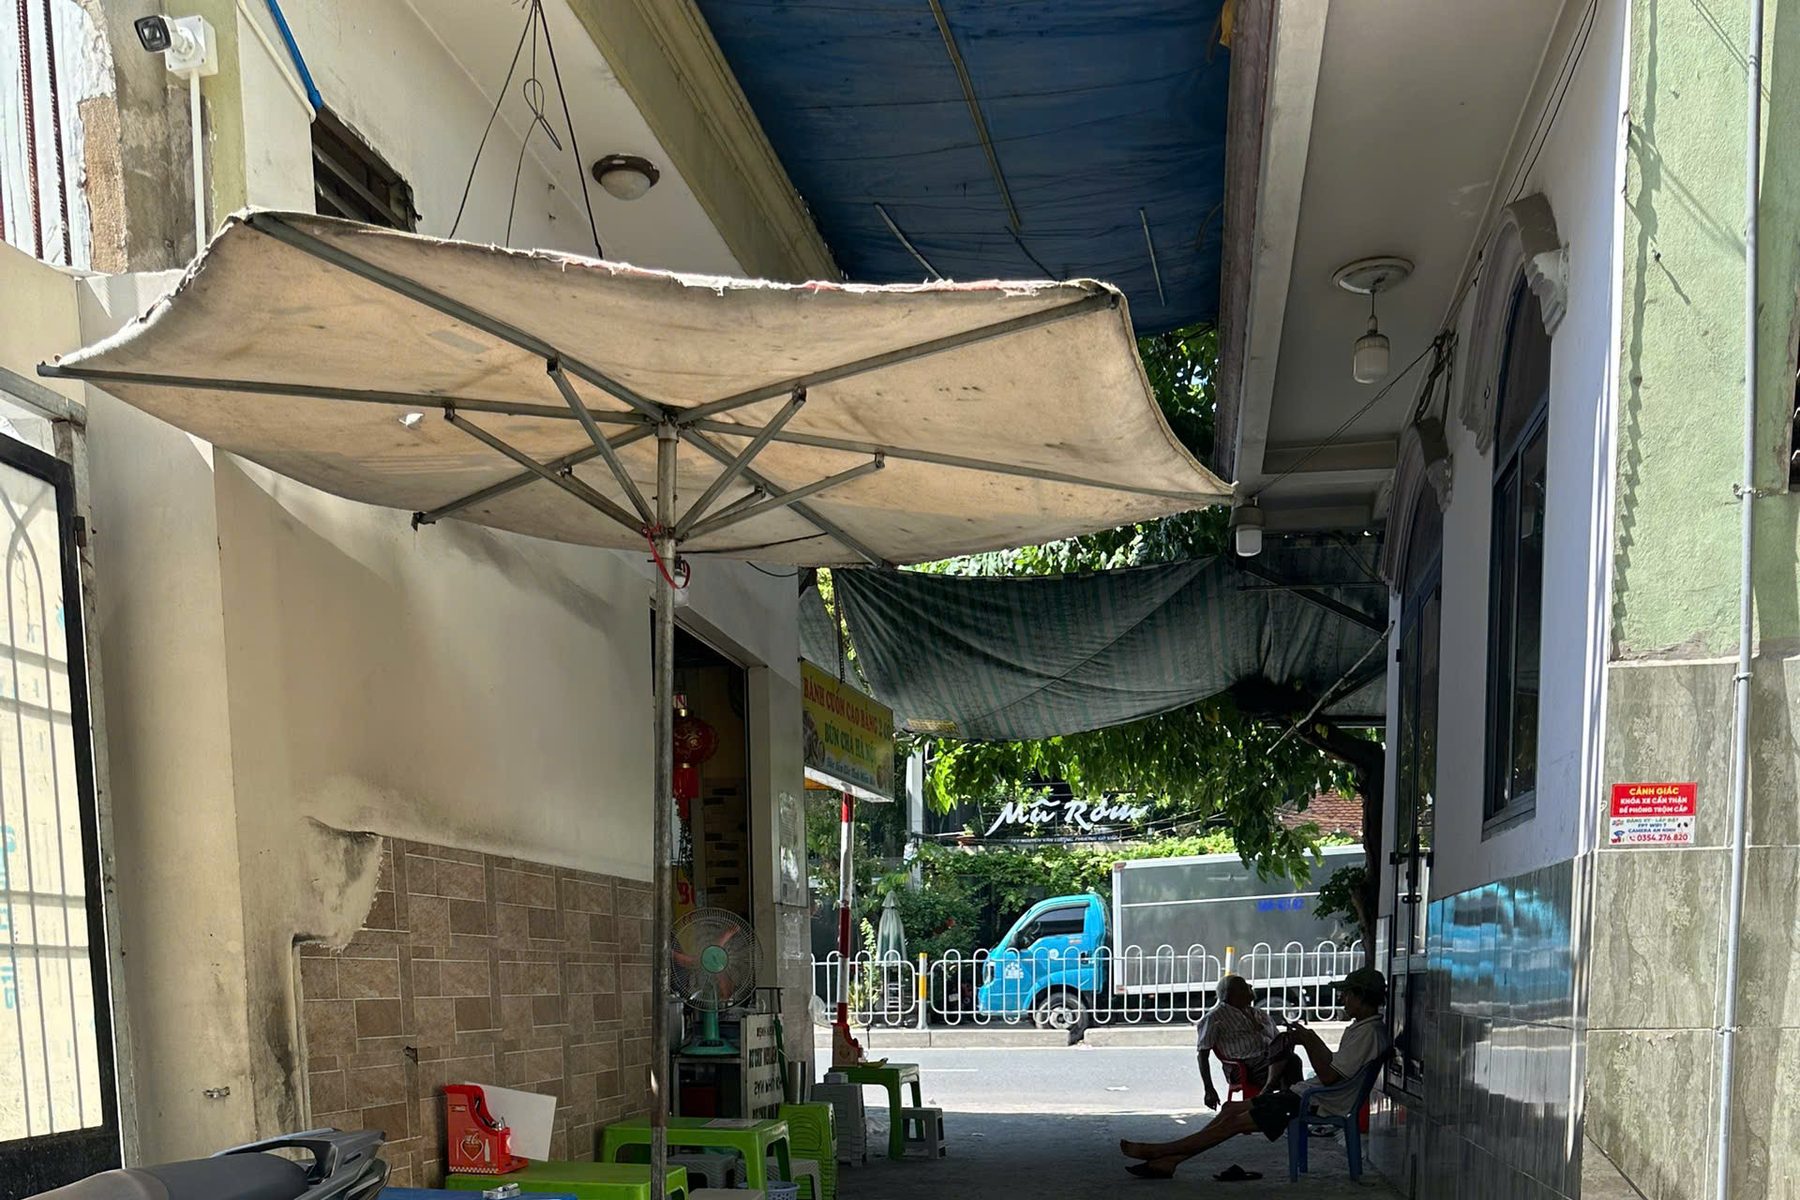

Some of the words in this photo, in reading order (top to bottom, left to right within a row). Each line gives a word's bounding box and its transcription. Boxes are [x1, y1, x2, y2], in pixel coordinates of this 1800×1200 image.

[803, 675, 825, 707] BÁNH
[826, 687, 845, 717] CUỐN
[1629, 786, 1655, 796] CẢNH
[1656, 785, 1680, 795] GIÁC
